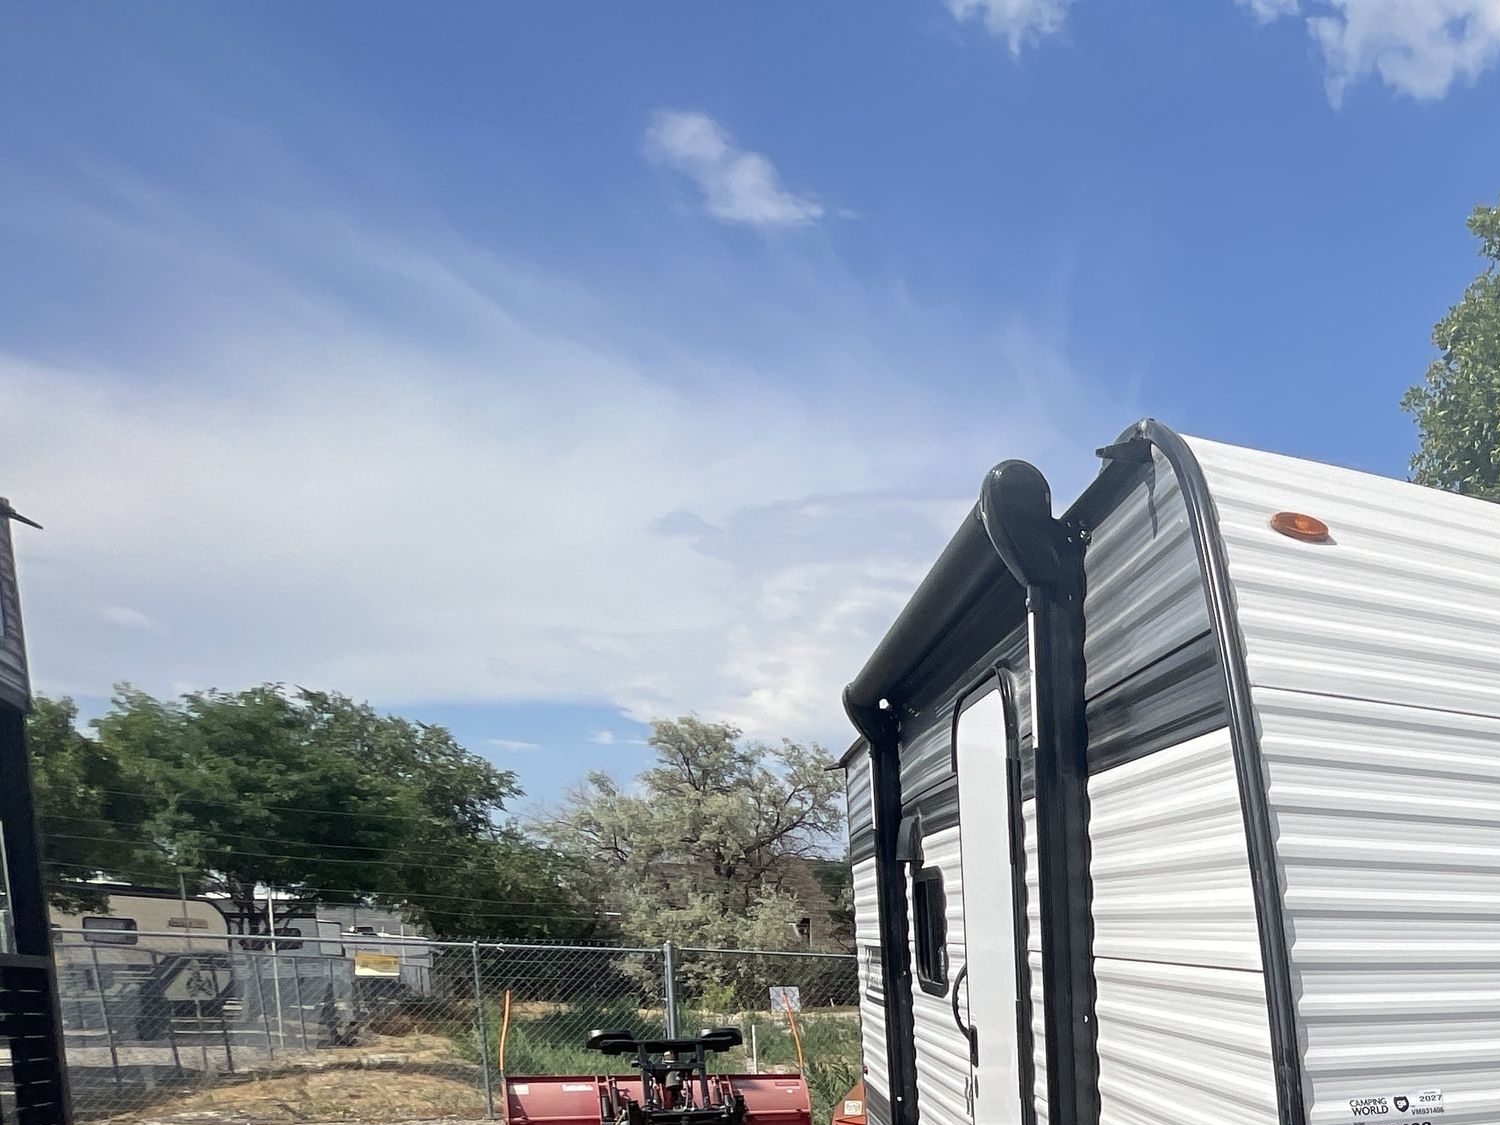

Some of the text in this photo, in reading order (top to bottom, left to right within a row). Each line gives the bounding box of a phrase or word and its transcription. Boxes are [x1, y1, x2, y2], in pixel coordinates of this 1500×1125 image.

[1349, 1098, 1387, 1107] CAMPING
[1419, 1094, 1442, 1102] 2027
[1351, 1105, 1389, 1116] WORLD
